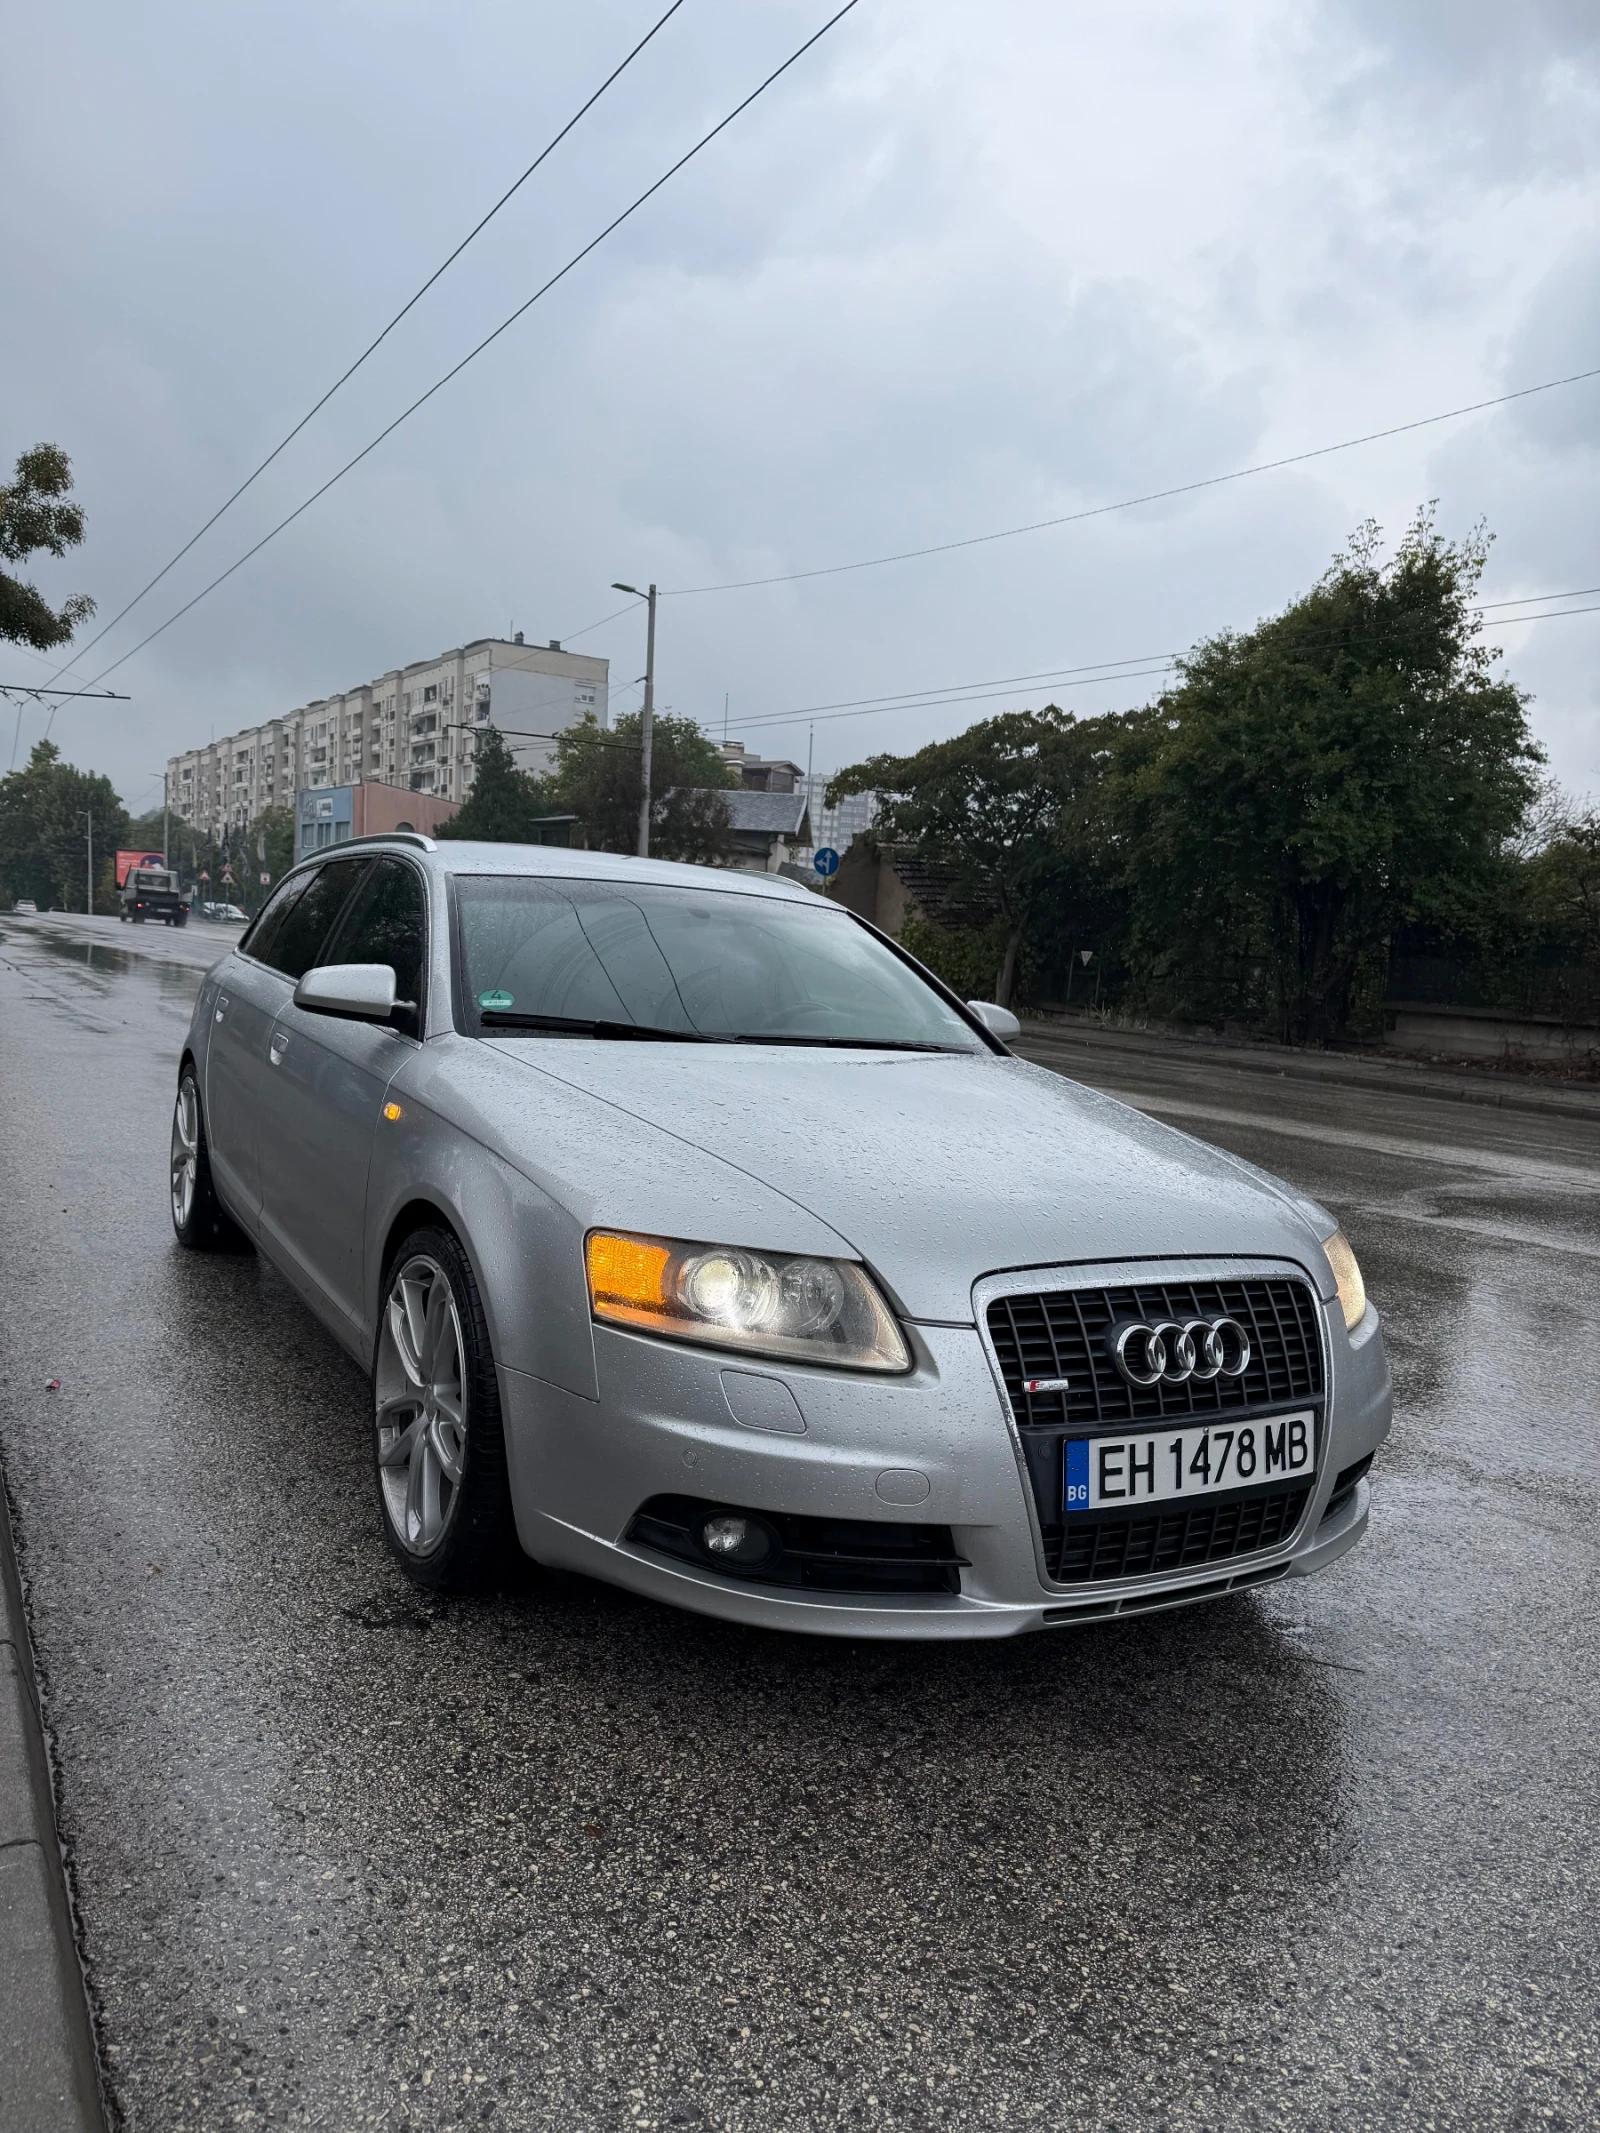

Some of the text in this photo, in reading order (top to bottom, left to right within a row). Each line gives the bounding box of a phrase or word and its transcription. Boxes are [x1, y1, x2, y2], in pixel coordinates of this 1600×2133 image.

[491, 990, 501, 999] 4
[1099, 1420, 1308, 1499] EH 1478 MB
[1067, 1485, 1087, 1501] BG
